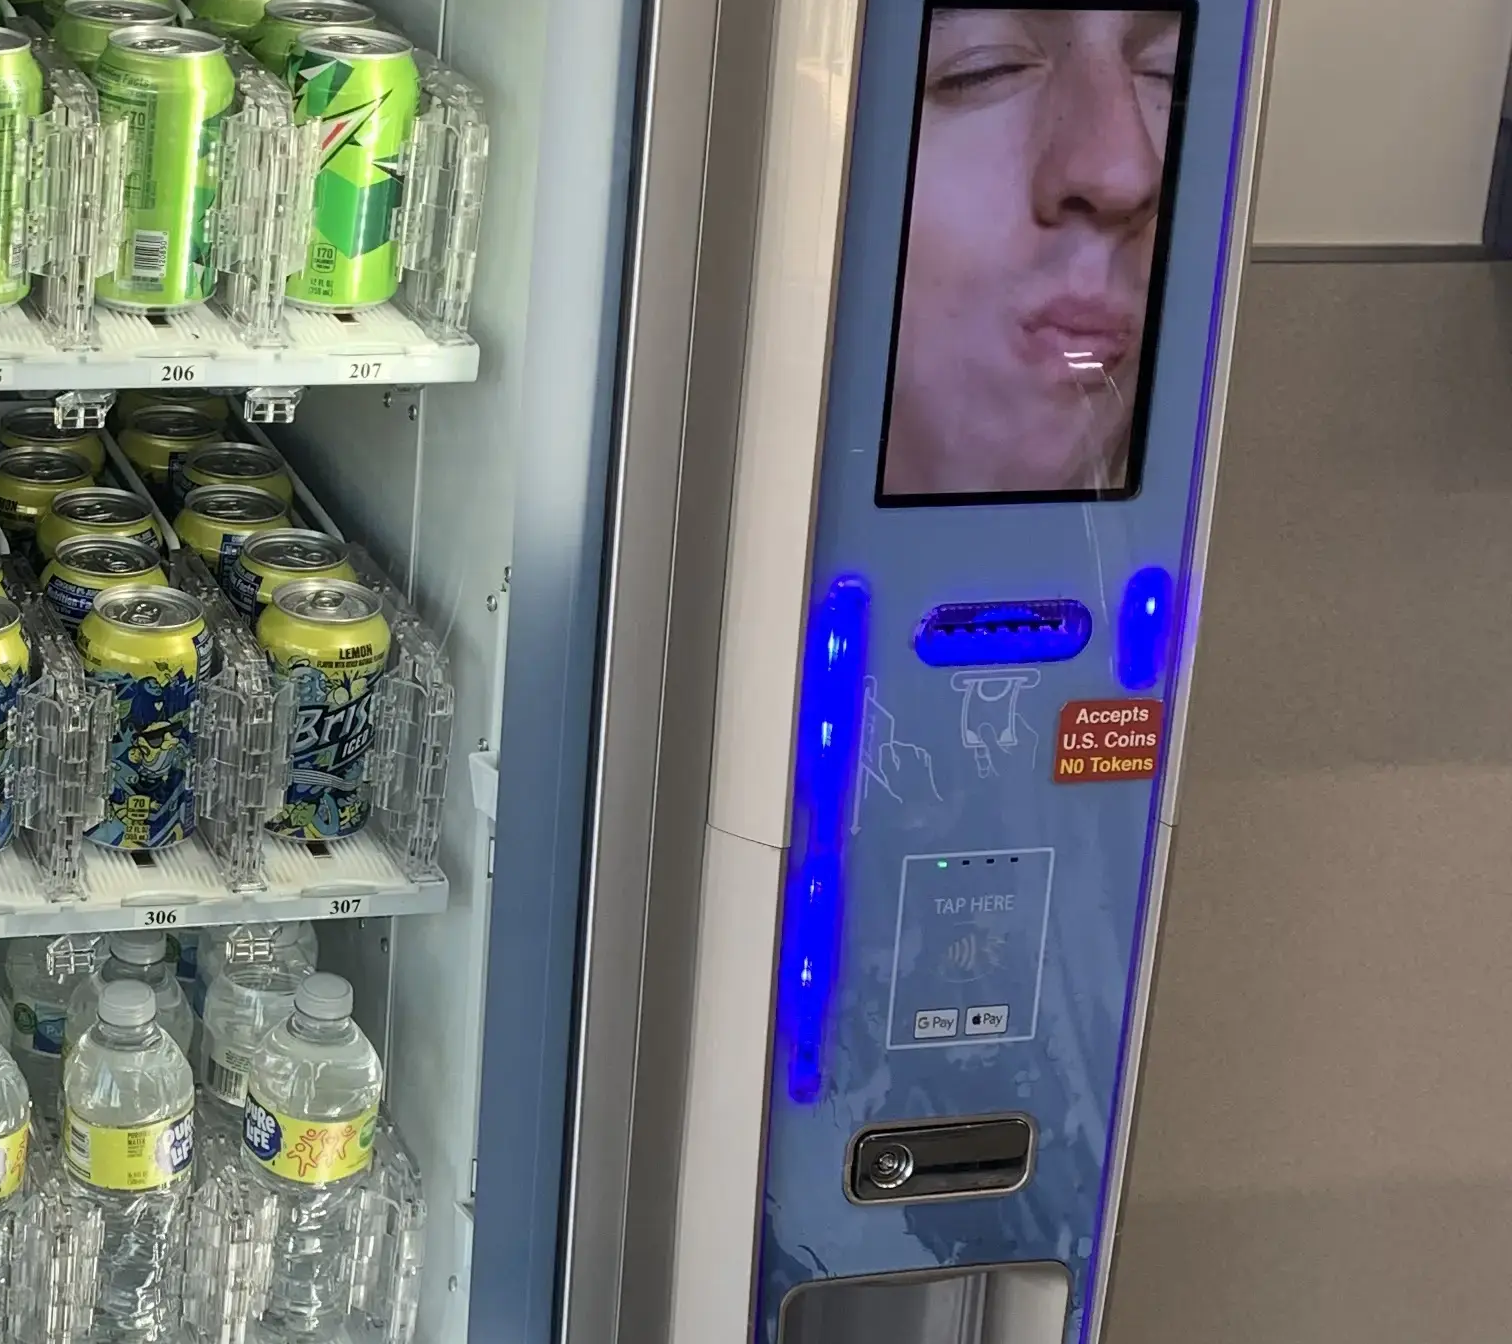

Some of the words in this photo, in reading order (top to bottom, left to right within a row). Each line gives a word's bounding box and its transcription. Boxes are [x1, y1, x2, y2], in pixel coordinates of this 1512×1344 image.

[317, 247, 333, 259] 170
[160, 364, 196, 383] 206
[348, 361, 383, 380] 207
[339, 643, 373, 661] LEMON
[293, 694, 370, 749] Bris
[1075, 706, 1150, 727] Accepts
[342, 731, 369, 759] ICED
[1063, 733, 1099, 750] U.S.
[1104, 730, 1157, 749] Coins
[1090, 756, 1154, 773] Tokens
[132, 798, 145, 808] 70
[329, 898, 362, 916] 307
[934, 897, 967, 915] TAP
[970, 894, 1015, 912] HERE
[143, 908, 178, 926] 306
[917, 1016, 930, 1030] G
[932, 1016, 955, 1031] Pay
[983, 1012, 1004, 1027] Pay
